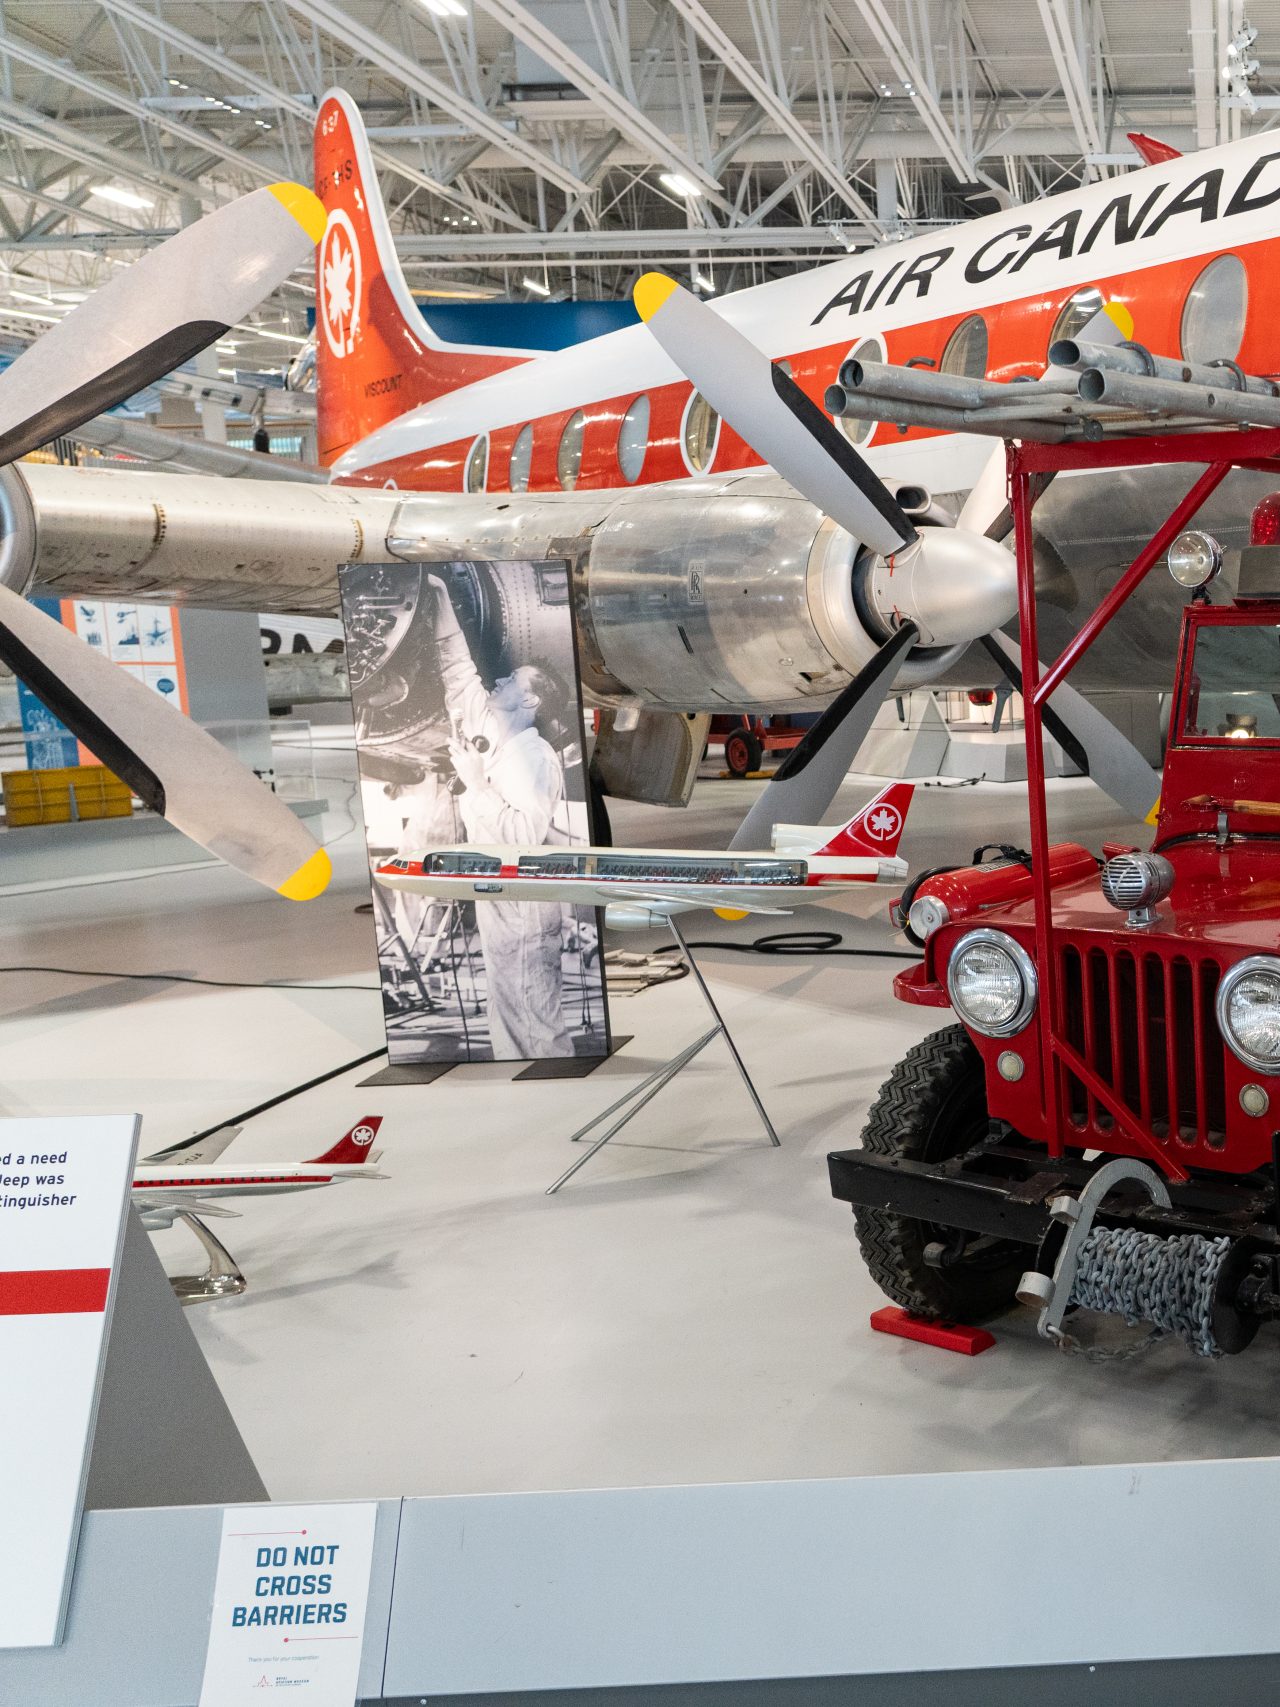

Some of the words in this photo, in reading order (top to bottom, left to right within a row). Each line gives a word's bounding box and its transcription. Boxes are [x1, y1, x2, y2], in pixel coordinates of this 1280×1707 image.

[322, 110, 339, 136] 637
[810, 246, 955, 327] AIR
[364, 374, 402, 399] VISCOUNT
[16, 1155, 25, 1165] a
[30, 1151, 68, 1165] need
[36, 1174, 65, 1185] was
[256, 1547, 287, 1568] DO
[293, 1545, 339, 1566] NOT
[255, 1574, 332, 1596] CROSS
[232, 1602, 348, 1627] BARRIERS
